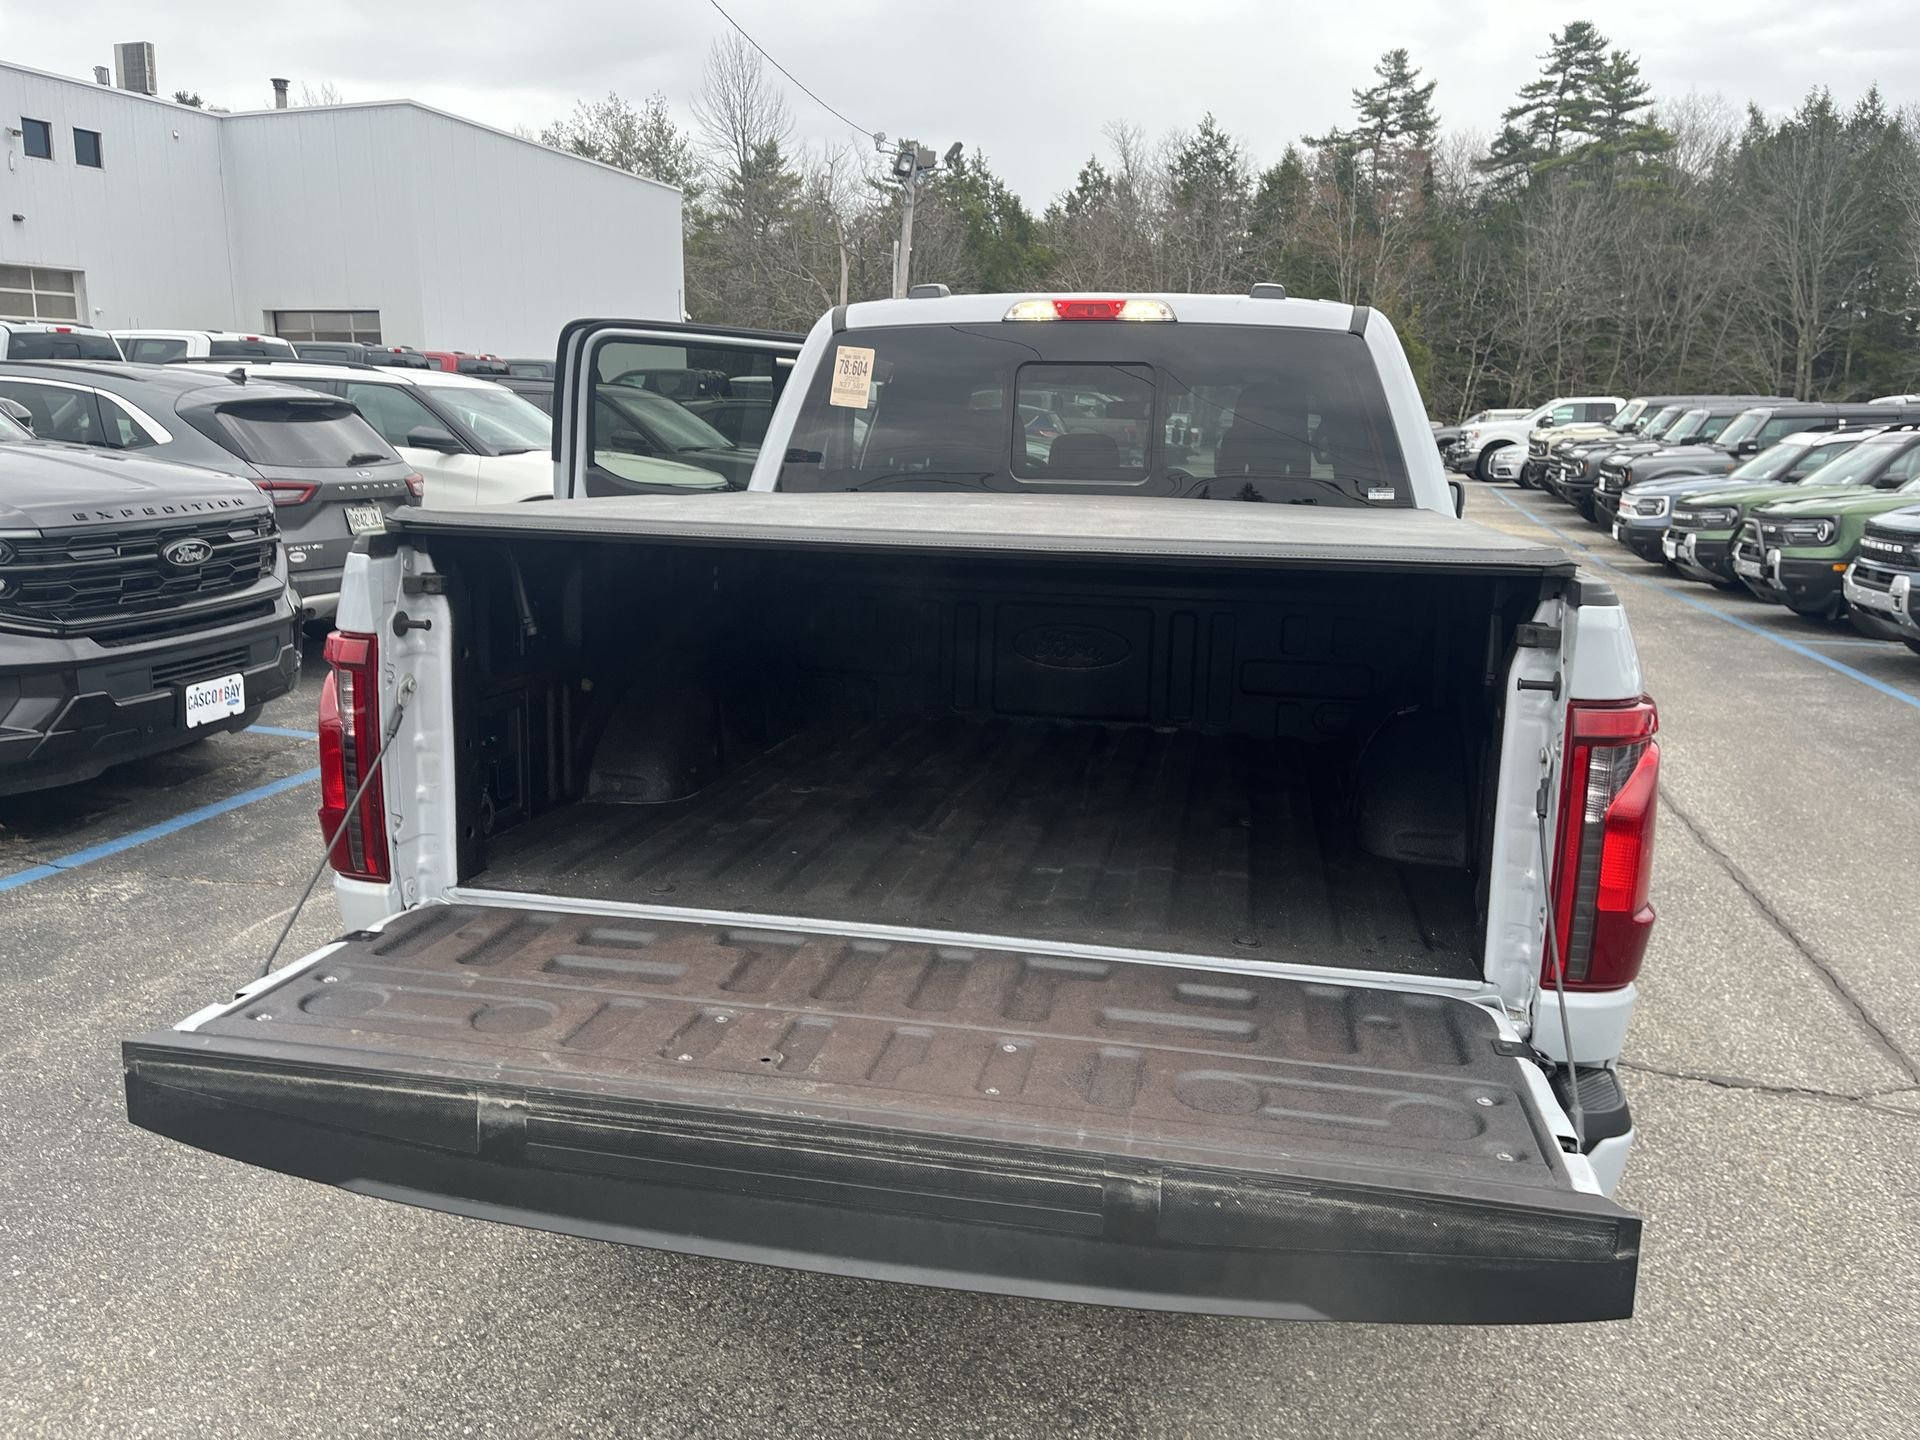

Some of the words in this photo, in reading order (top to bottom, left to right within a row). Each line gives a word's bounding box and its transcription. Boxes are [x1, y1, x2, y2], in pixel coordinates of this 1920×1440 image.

[72, 498, 245, 521] EXPEDITION
[188, 688, 218, 710] CASCO
[224, 682, 241, 700] BAY
